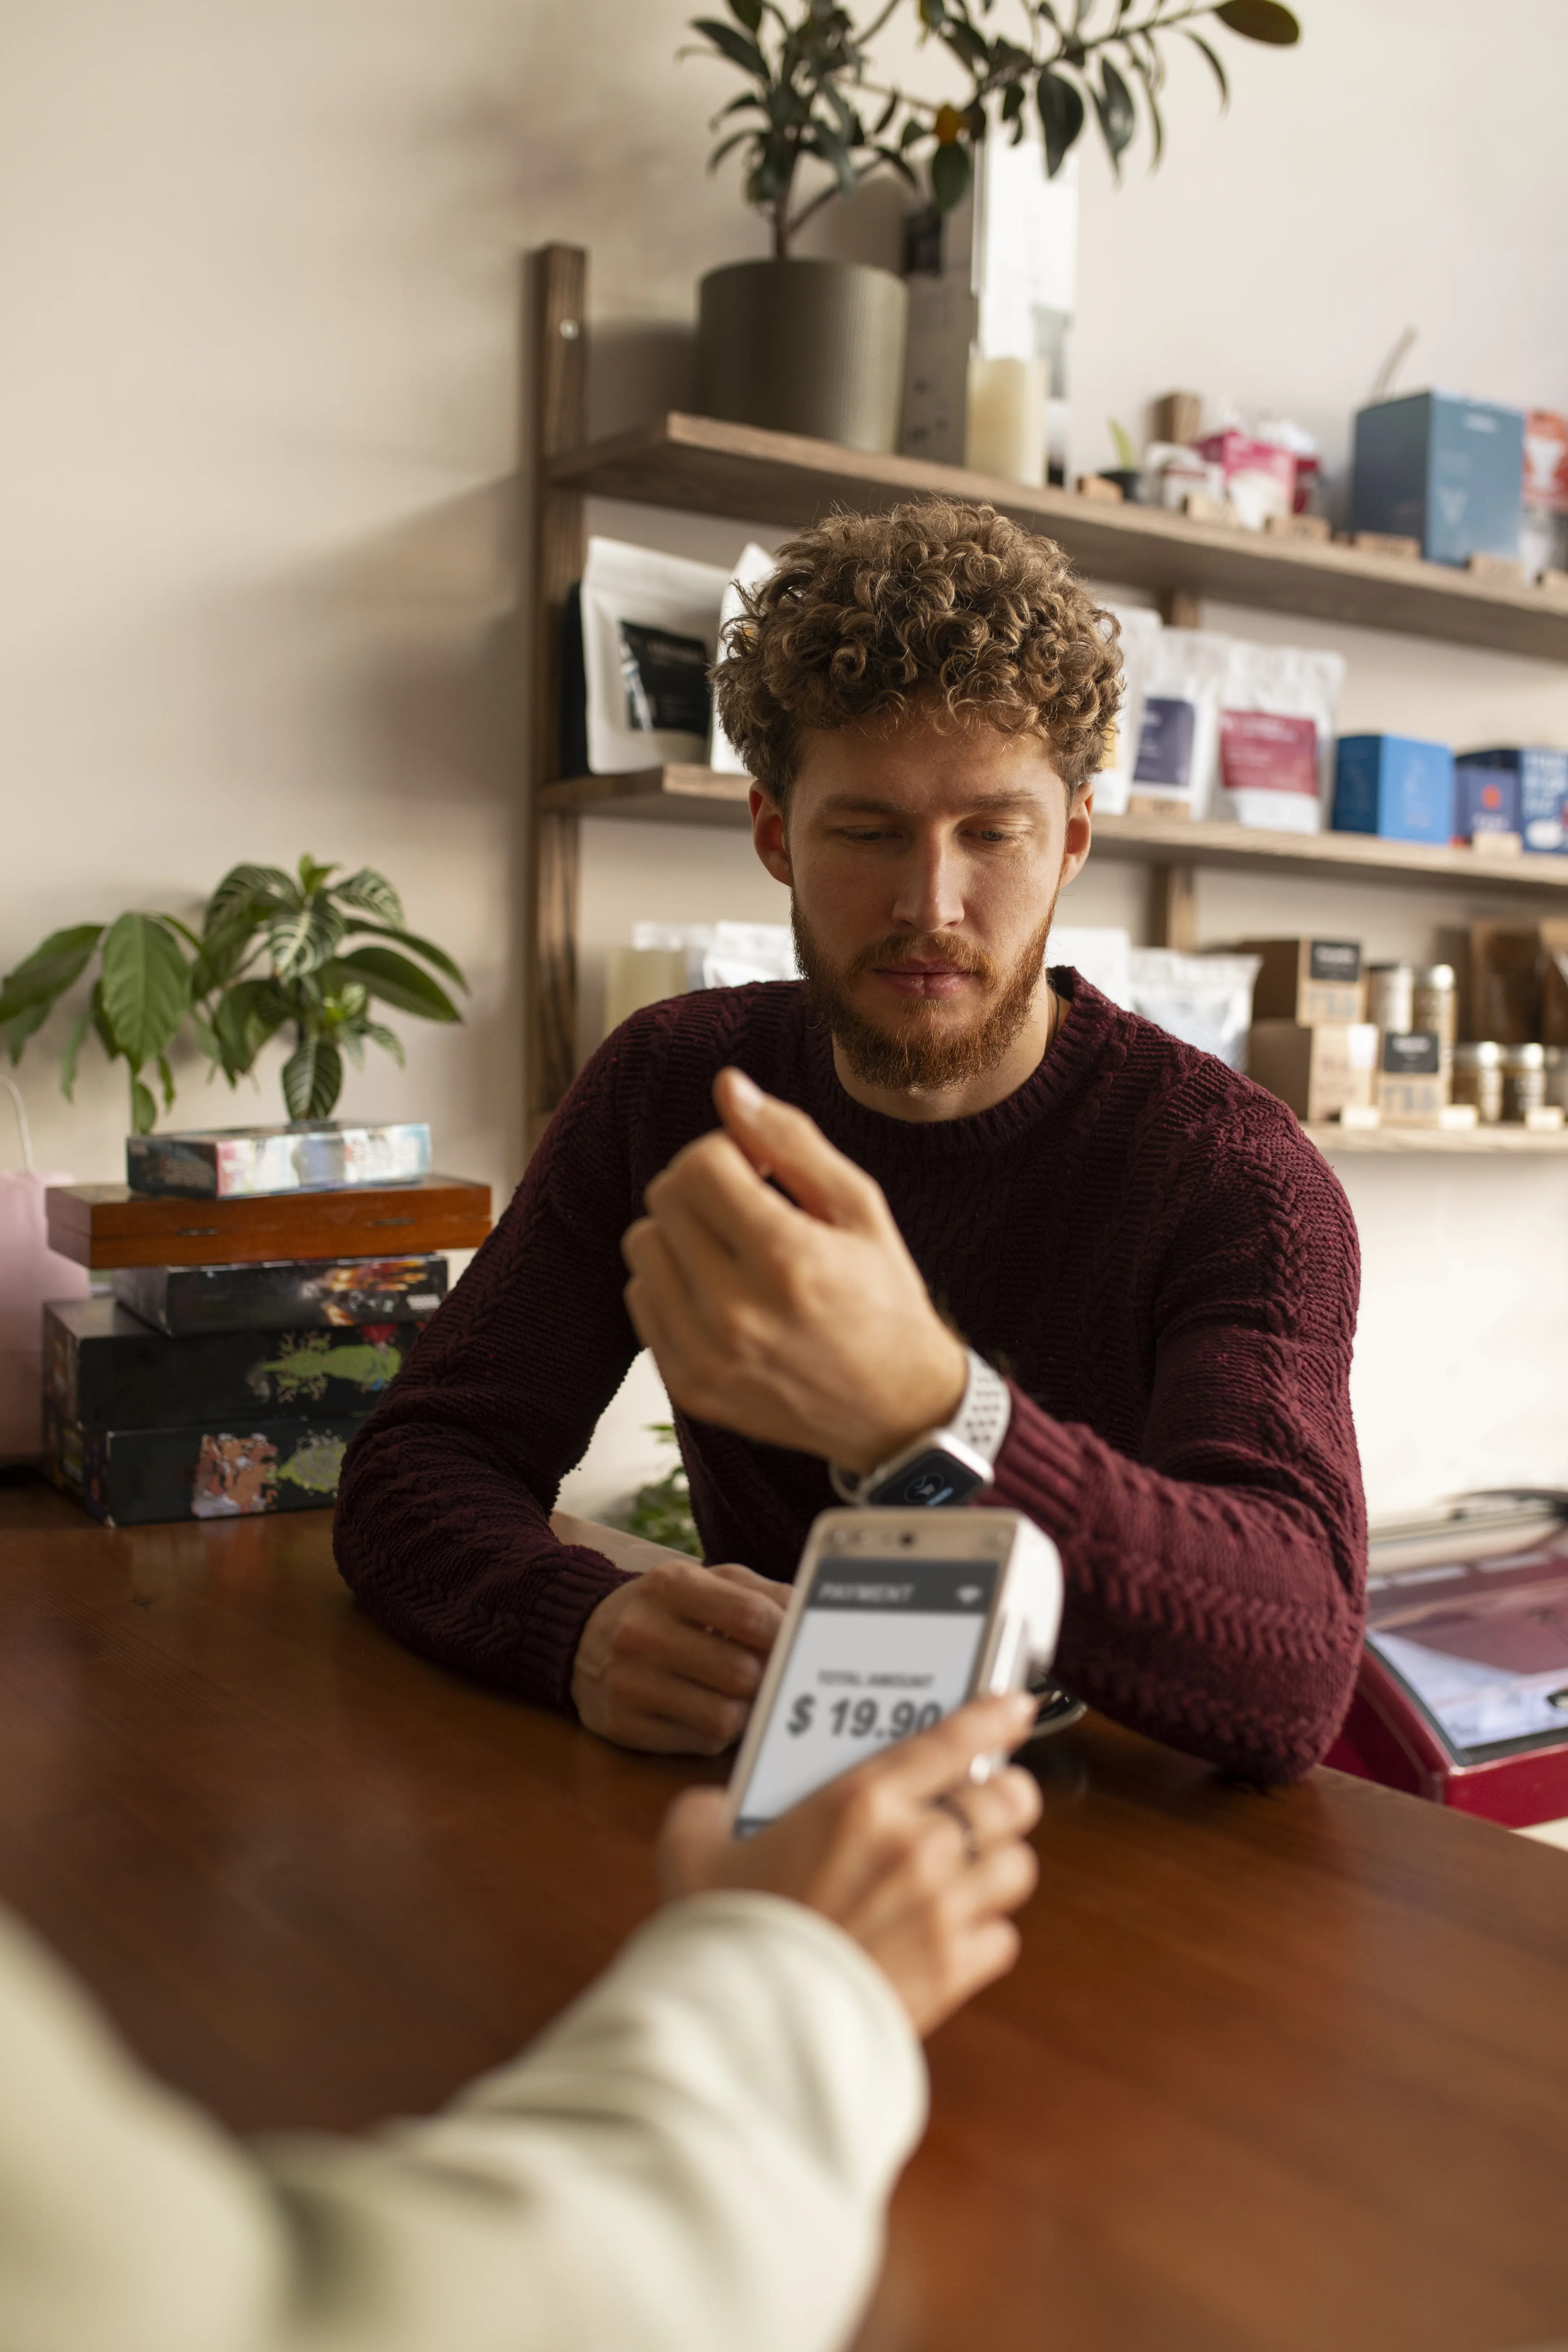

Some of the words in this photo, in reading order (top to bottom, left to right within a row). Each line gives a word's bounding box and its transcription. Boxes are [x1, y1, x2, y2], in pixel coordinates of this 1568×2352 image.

[818, 1583, 915, 1603] PAYMENT
[817, 1669, 860, 1686] TOTAL
[868, 1672, 934, 1690] AMOUNT
[787, 1693, 816, 1740] $
